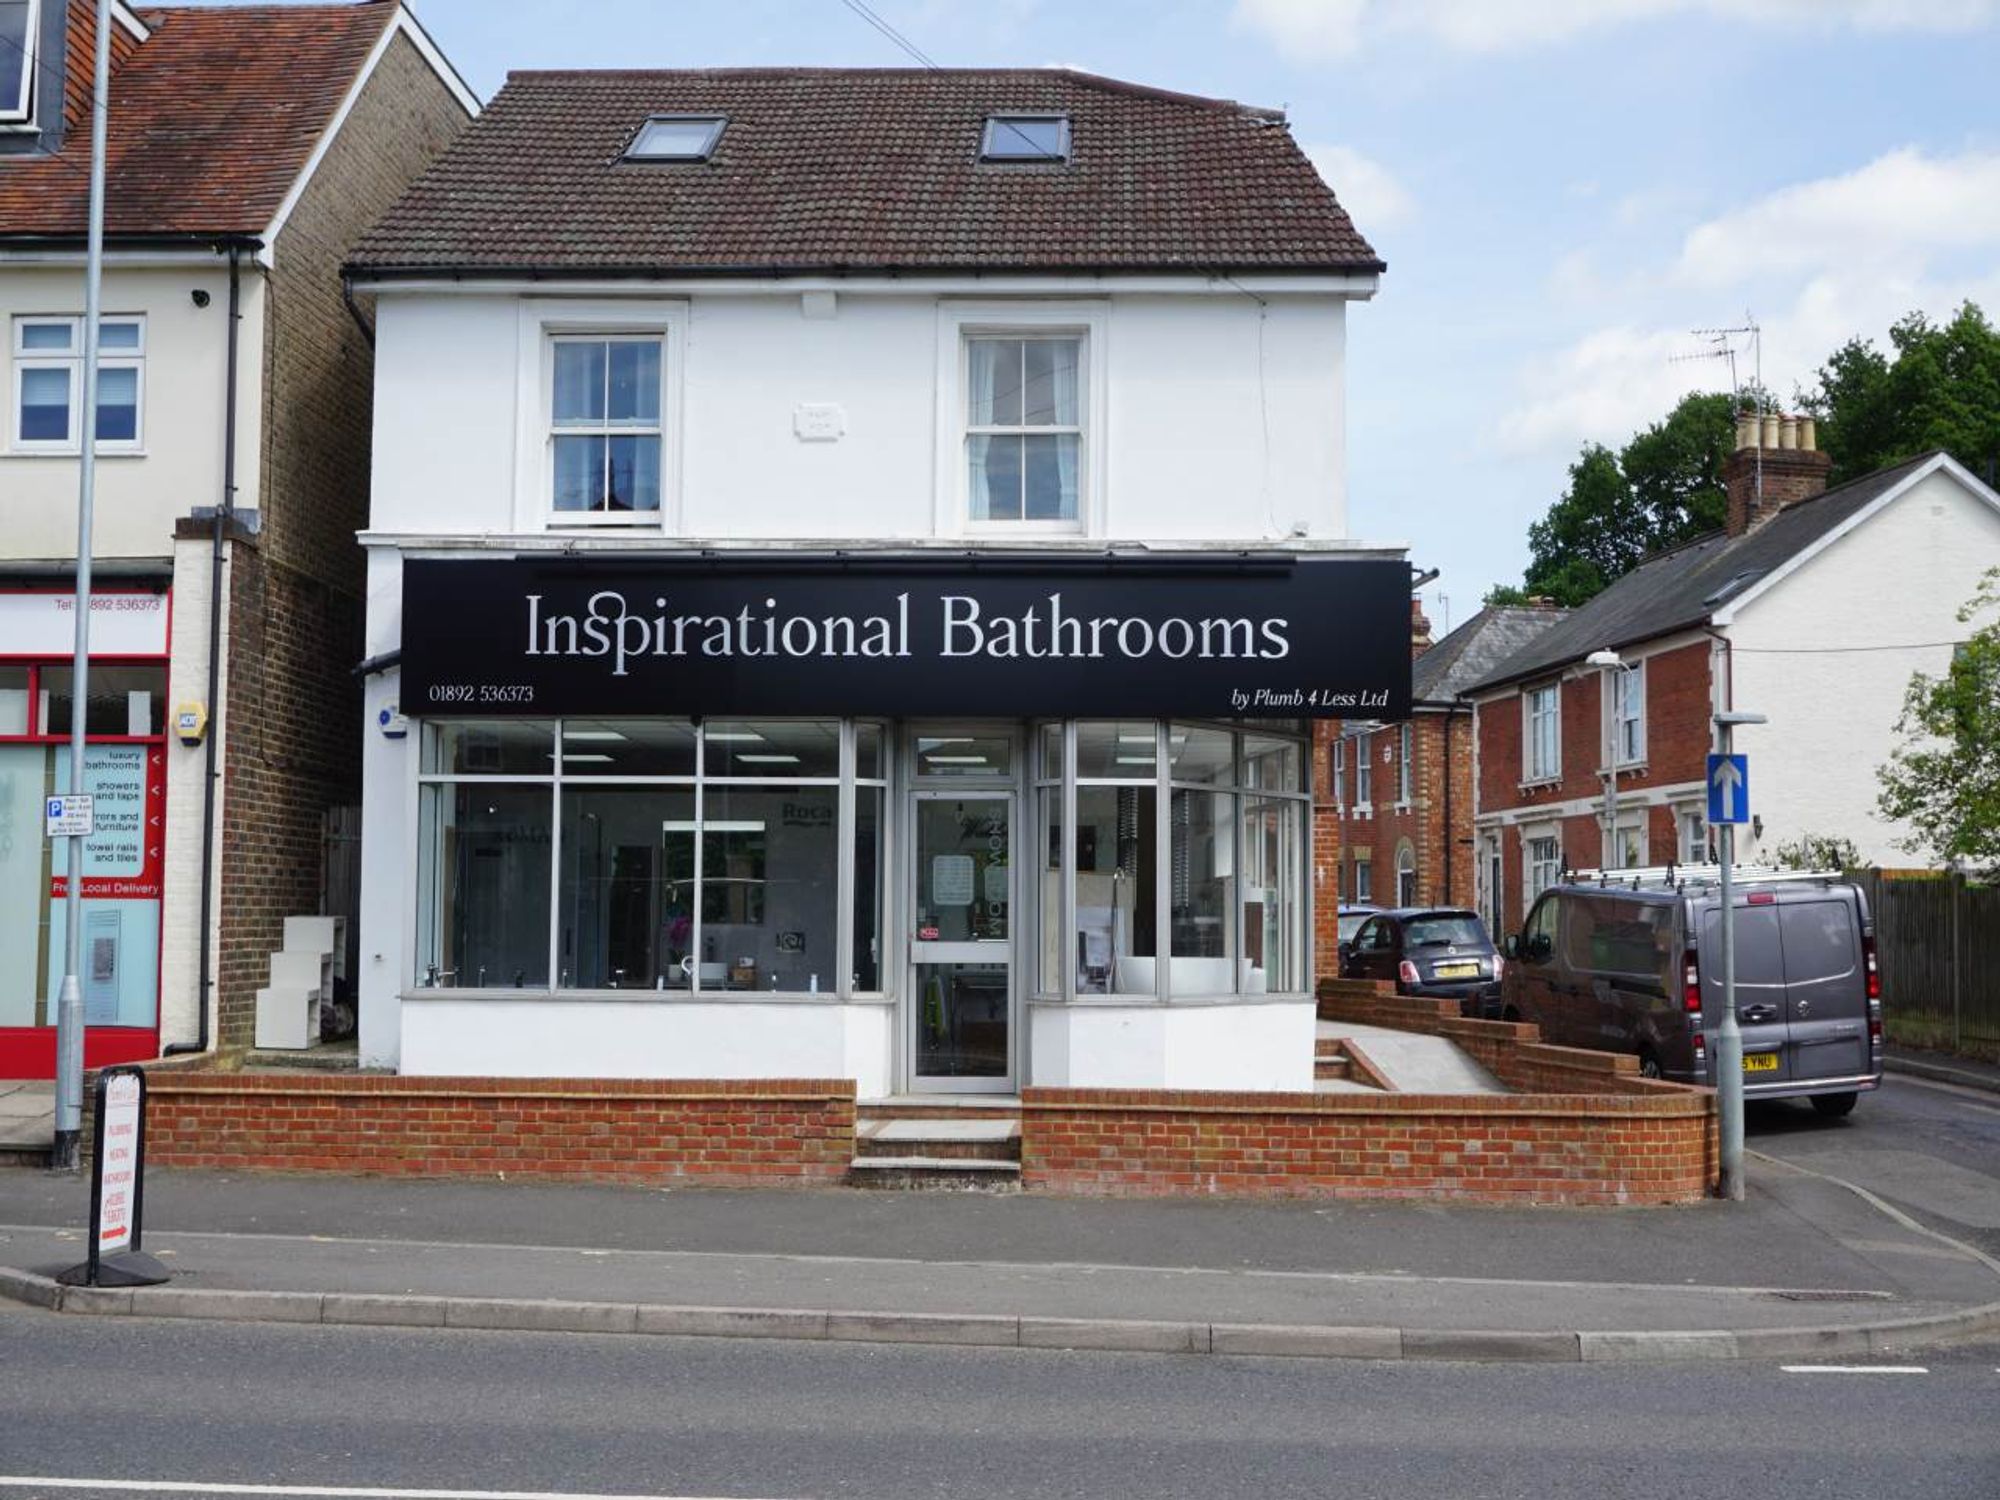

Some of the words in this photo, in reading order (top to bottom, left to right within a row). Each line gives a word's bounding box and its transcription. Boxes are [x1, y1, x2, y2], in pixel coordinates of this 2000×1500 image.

[114, 599, 160, 611] 536373
[525, 591, 912, 675] Inspirational
[940, 593, 1290, 659] Bathrooms
[429, 685, 475, 701] 01892
[480, 685, 533, 701] 536373
[1231, 688, 1250, 711] by
[1254, 688, 1303, 706] Plumb
[1308, 689, 1317, 706] 4
[1321, 689, 1357, 706] Less
[1360, 689, 1389, 706] Ltd
[85, 760, 140, 770] bathrooms
[96, 781, 140, 790] showers
[94, 812, 117, 821] rrors
[81, 882, 111, 893] Local
[114, 882, 159, 896] Delivery
